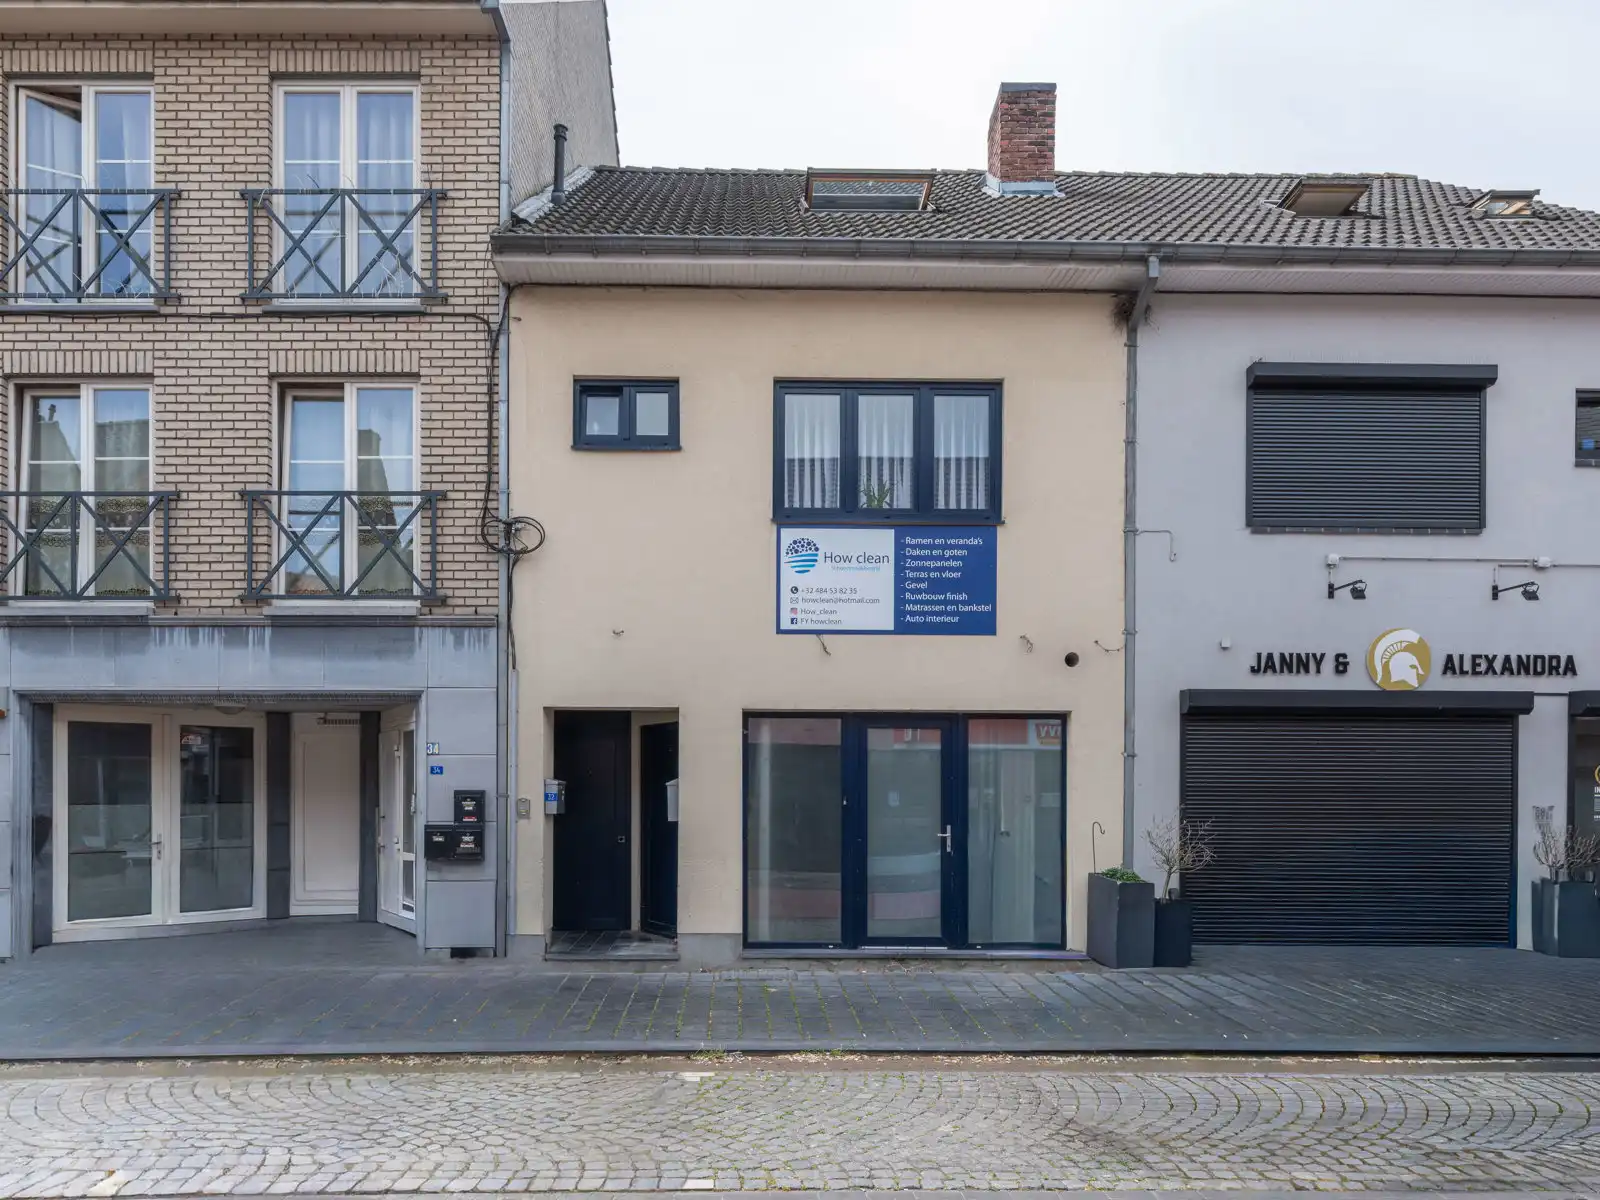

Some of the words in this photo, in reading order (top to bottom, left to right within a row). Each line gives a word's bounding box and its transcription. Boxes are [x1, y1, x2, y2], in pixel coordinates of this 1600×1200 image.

[905, 536, 933, 545] Ramen
[946, 536, 983, 545] veranda's
[905, 547, 930, 556] Daken
[944, 548, 968, 558] goten
[824, 551, 853, 564] How
[856, 551, 890, 564] clean
[905, 558, 963, 568] Zonnepanelen
[905, 570, 928, 578] Terras
[941, 570, 962, 578] vloer
[905, 581, 928, 589] Gevel
[849, 587, 858, 595] 35
[905, 592, 945, 600] Ruwbouw
[946, 591, 968, 600] finish
[801, 597, 880, 605] howclean@hotmail.com
[800, 608, 838, 616] How_clean
[905, 603, 945, 611] Matrassen
[958, 603, 992, 612] bankstel
[905, 614, 925, 623] Auto
[926, 614, 960, 623] interieur
[1249, 652, 1326, 675] JANNY
[1334, 652, 1350, 675] &
[1441, 653, 1578, 677] ALEXANDRA
[427, 743, 439, 754] 34
[432, 766, 441, 774] 34
[547, 793, 556, 801] 32
